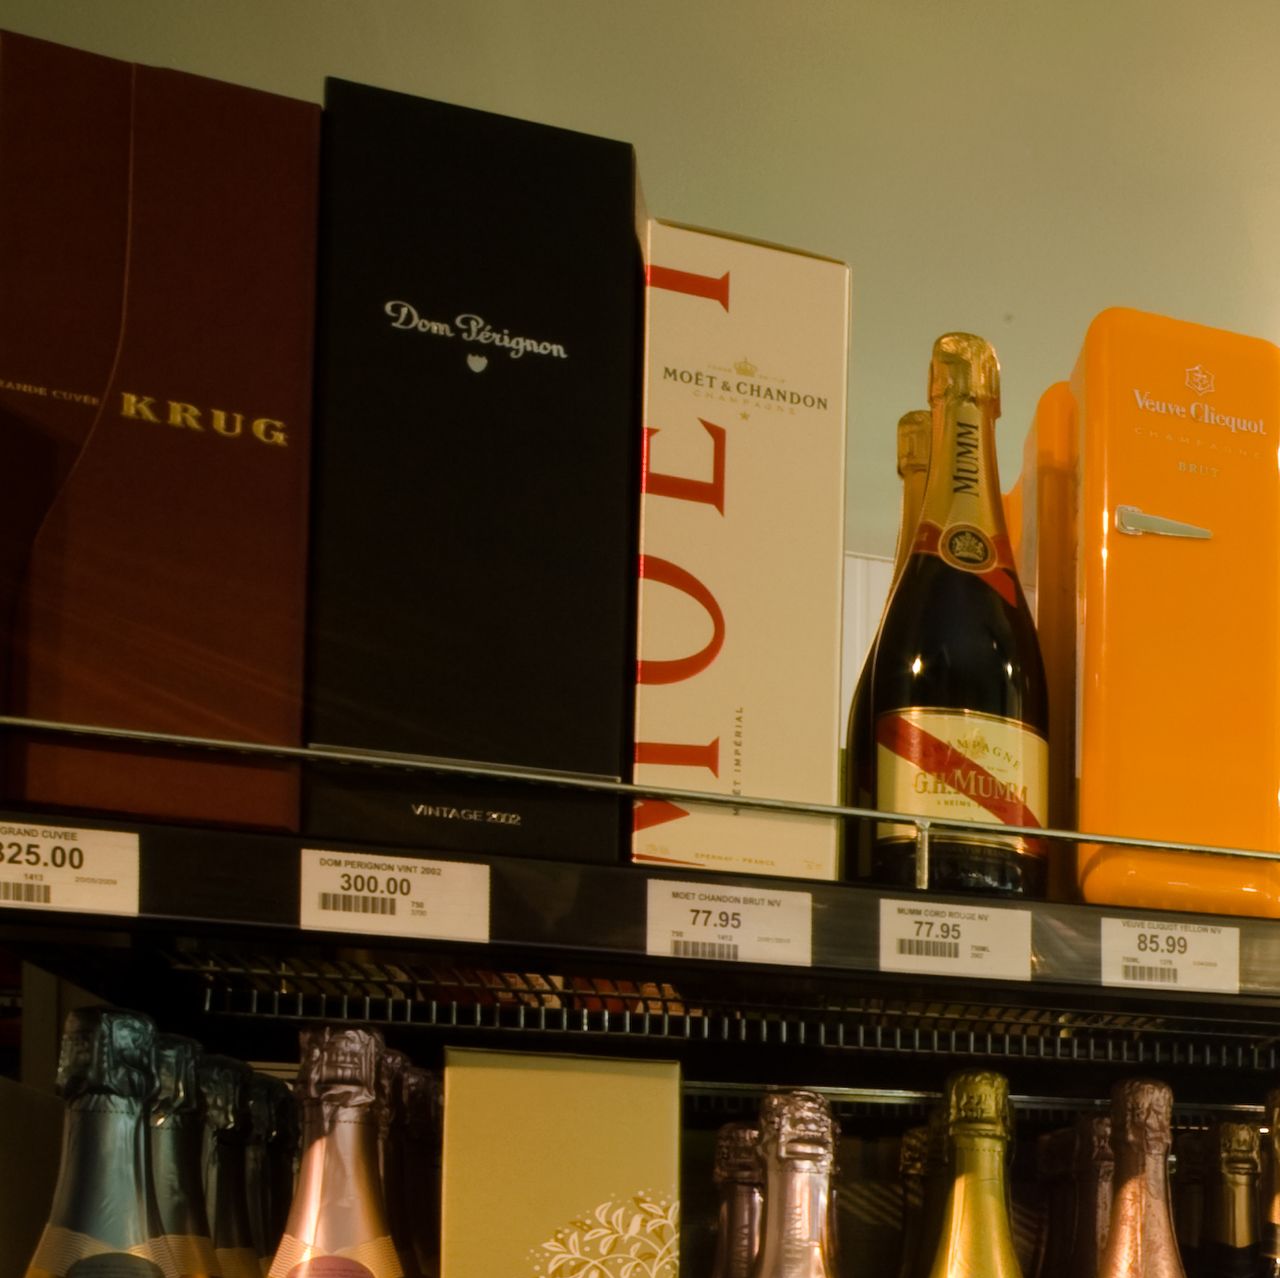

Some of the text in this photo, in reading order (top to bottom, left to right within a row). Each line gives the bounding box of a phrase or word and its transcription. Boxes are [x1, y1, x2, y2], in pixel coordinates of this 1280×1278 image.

[385, 300, 567, 361] Dom Pérignon
[663, 367, 828, 410] MOËT CHANDON
[121, 392, 288, 447] KRUG
[1133, 389, 1266, 435] Veuve Clicquot
[953, 422, 979, 497] MUMM
[1178, 461, 1220, 477] BRUT
[411, 804, 483, 821] VINTAGE
[42, 830, 78, 840] CUVEE
[319, 858, 418, 873] DOM PERIGNON VINT
[340, 872, 411, 896] 300.00
[671, 891, 764, 907] MOET CHANDON BRUT
[689, 908, 741, 929] 77.95
[923, 909, 946, 918] CORD
[913, 921, 961, 939] 77.95
[1137, 933, 1188, 954] 85.99
